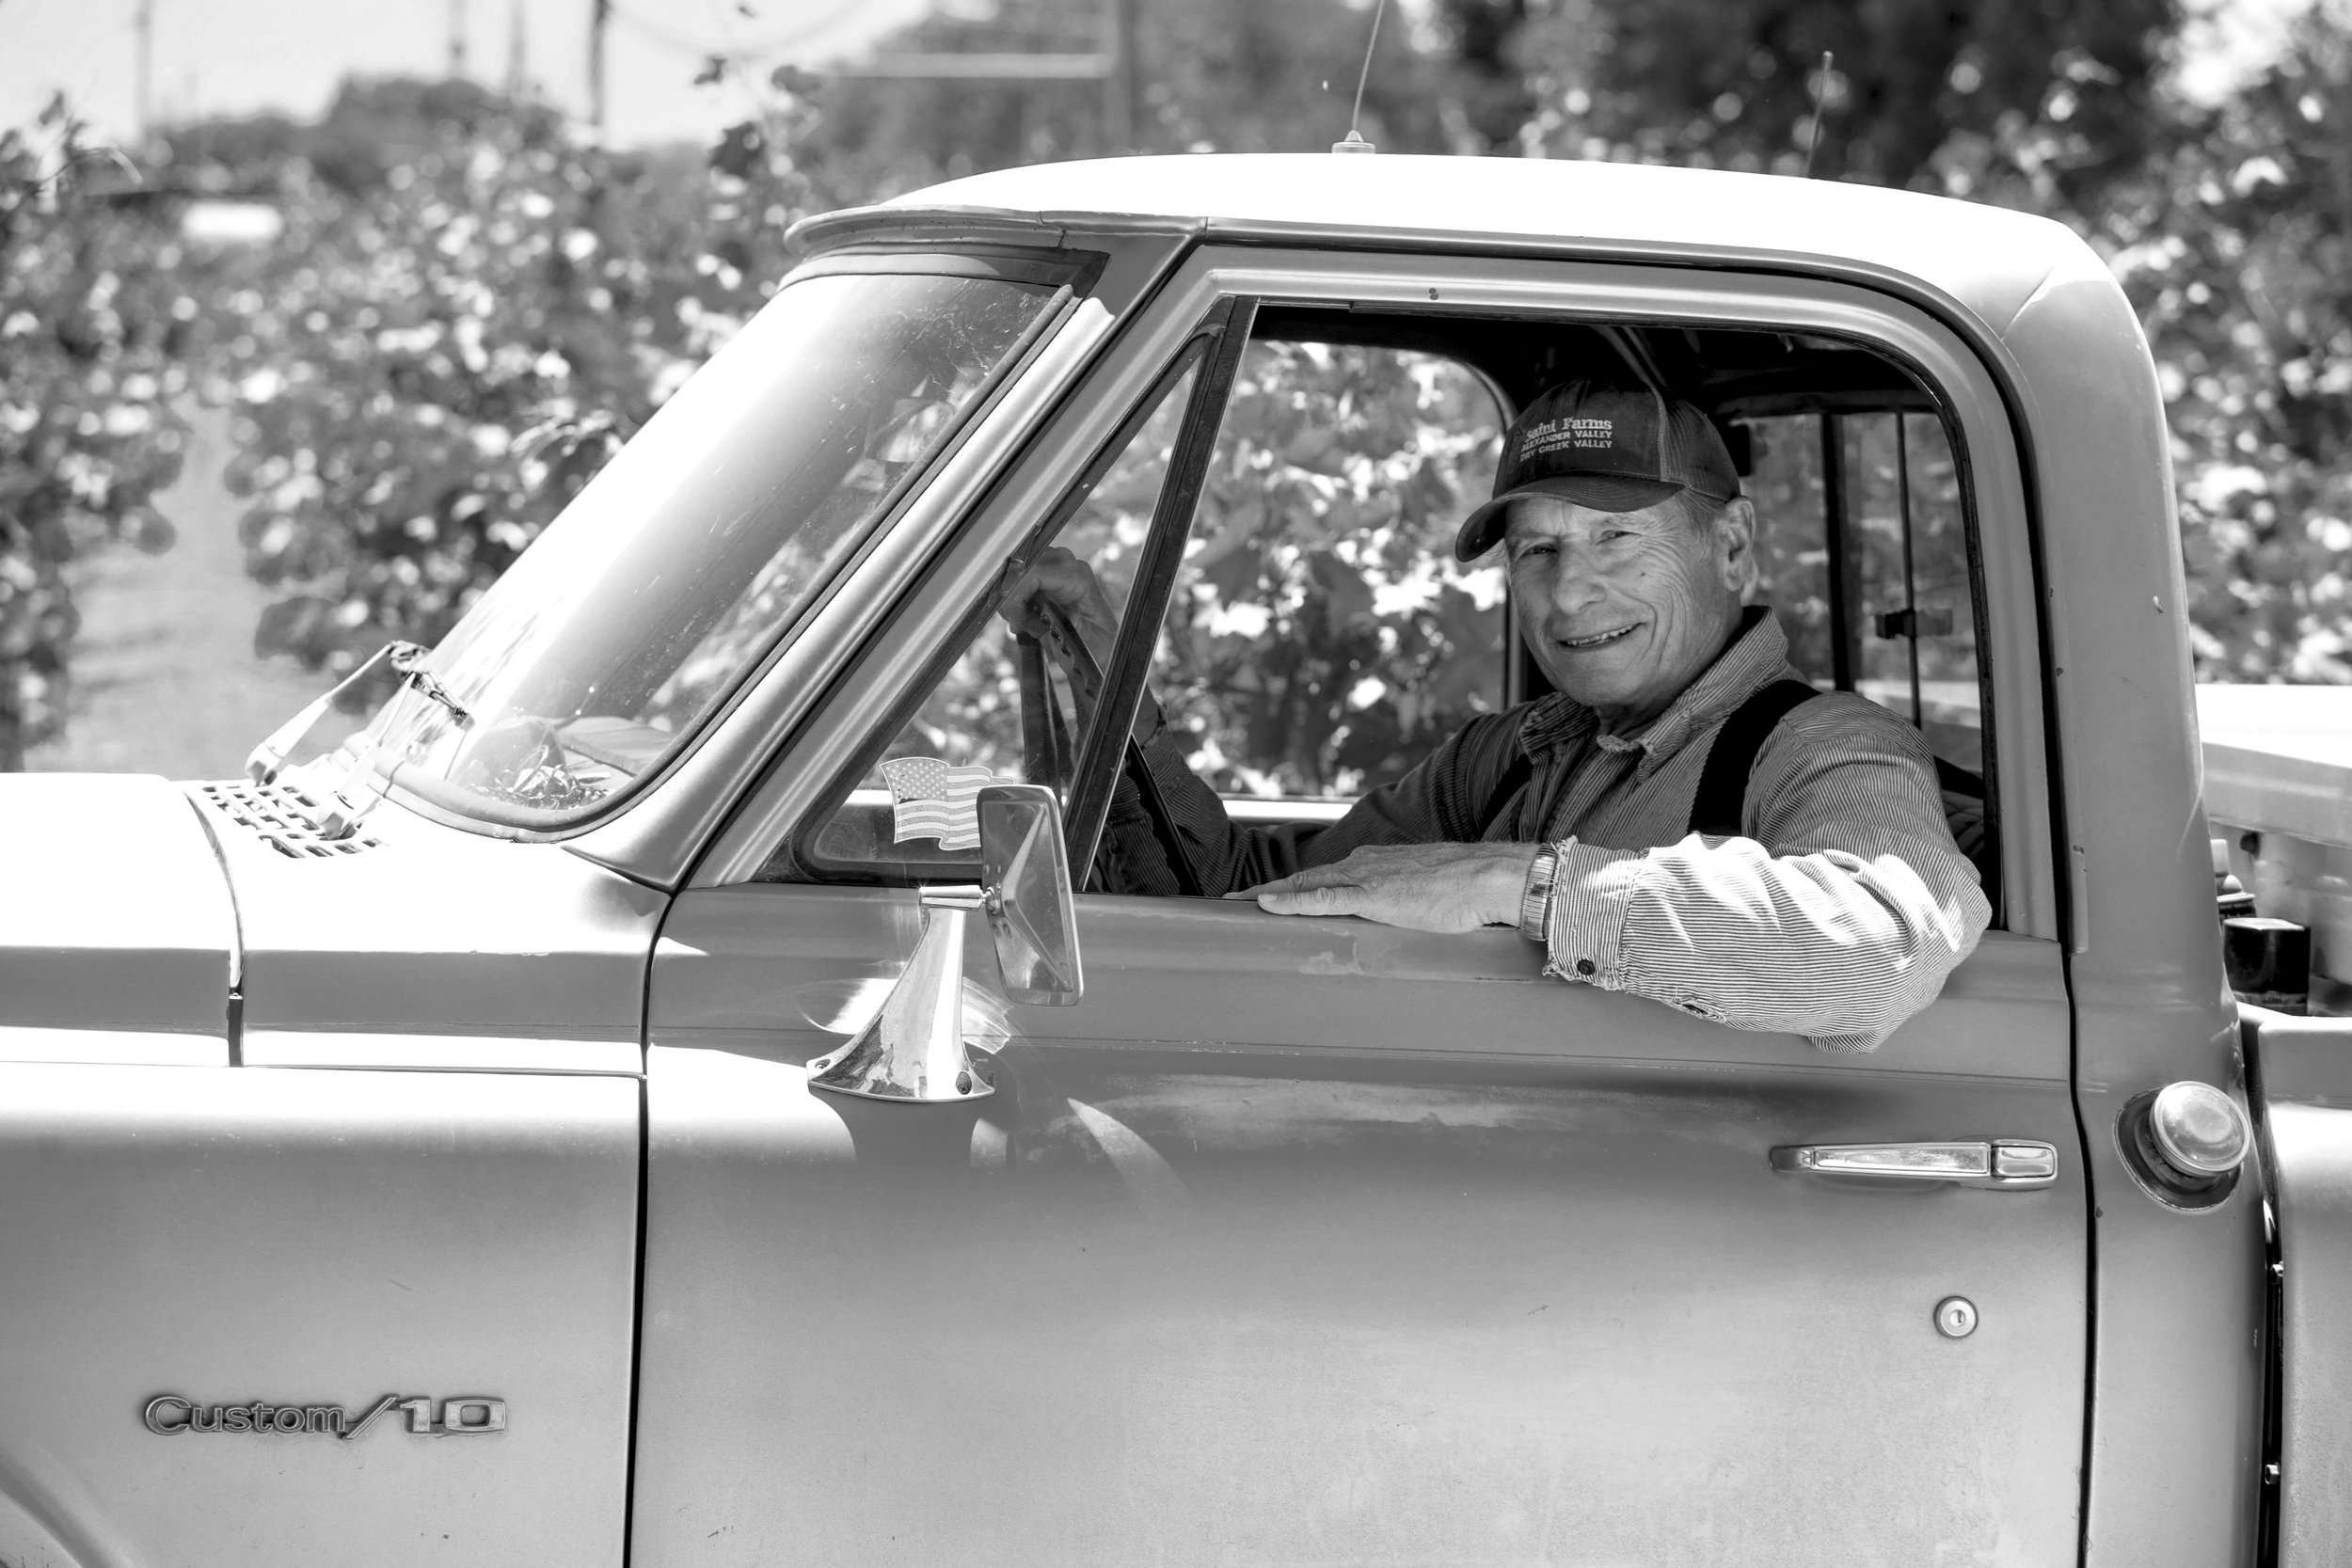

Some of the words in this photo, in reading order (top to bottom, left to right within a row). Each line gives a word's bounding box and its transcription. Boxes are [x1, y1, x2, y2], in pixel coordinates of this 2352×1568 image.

[1562, 417, 1613, 431] Farms
[1519, 449, 1535, 463] DRY
[1538, 440, 1569, 453] CREEK
[1574, 439, 1613, 449] VALLEY
[1521, 431, 1571, 452] ALEXANDER
[1574, 430, 1613, 439] VALLEY
